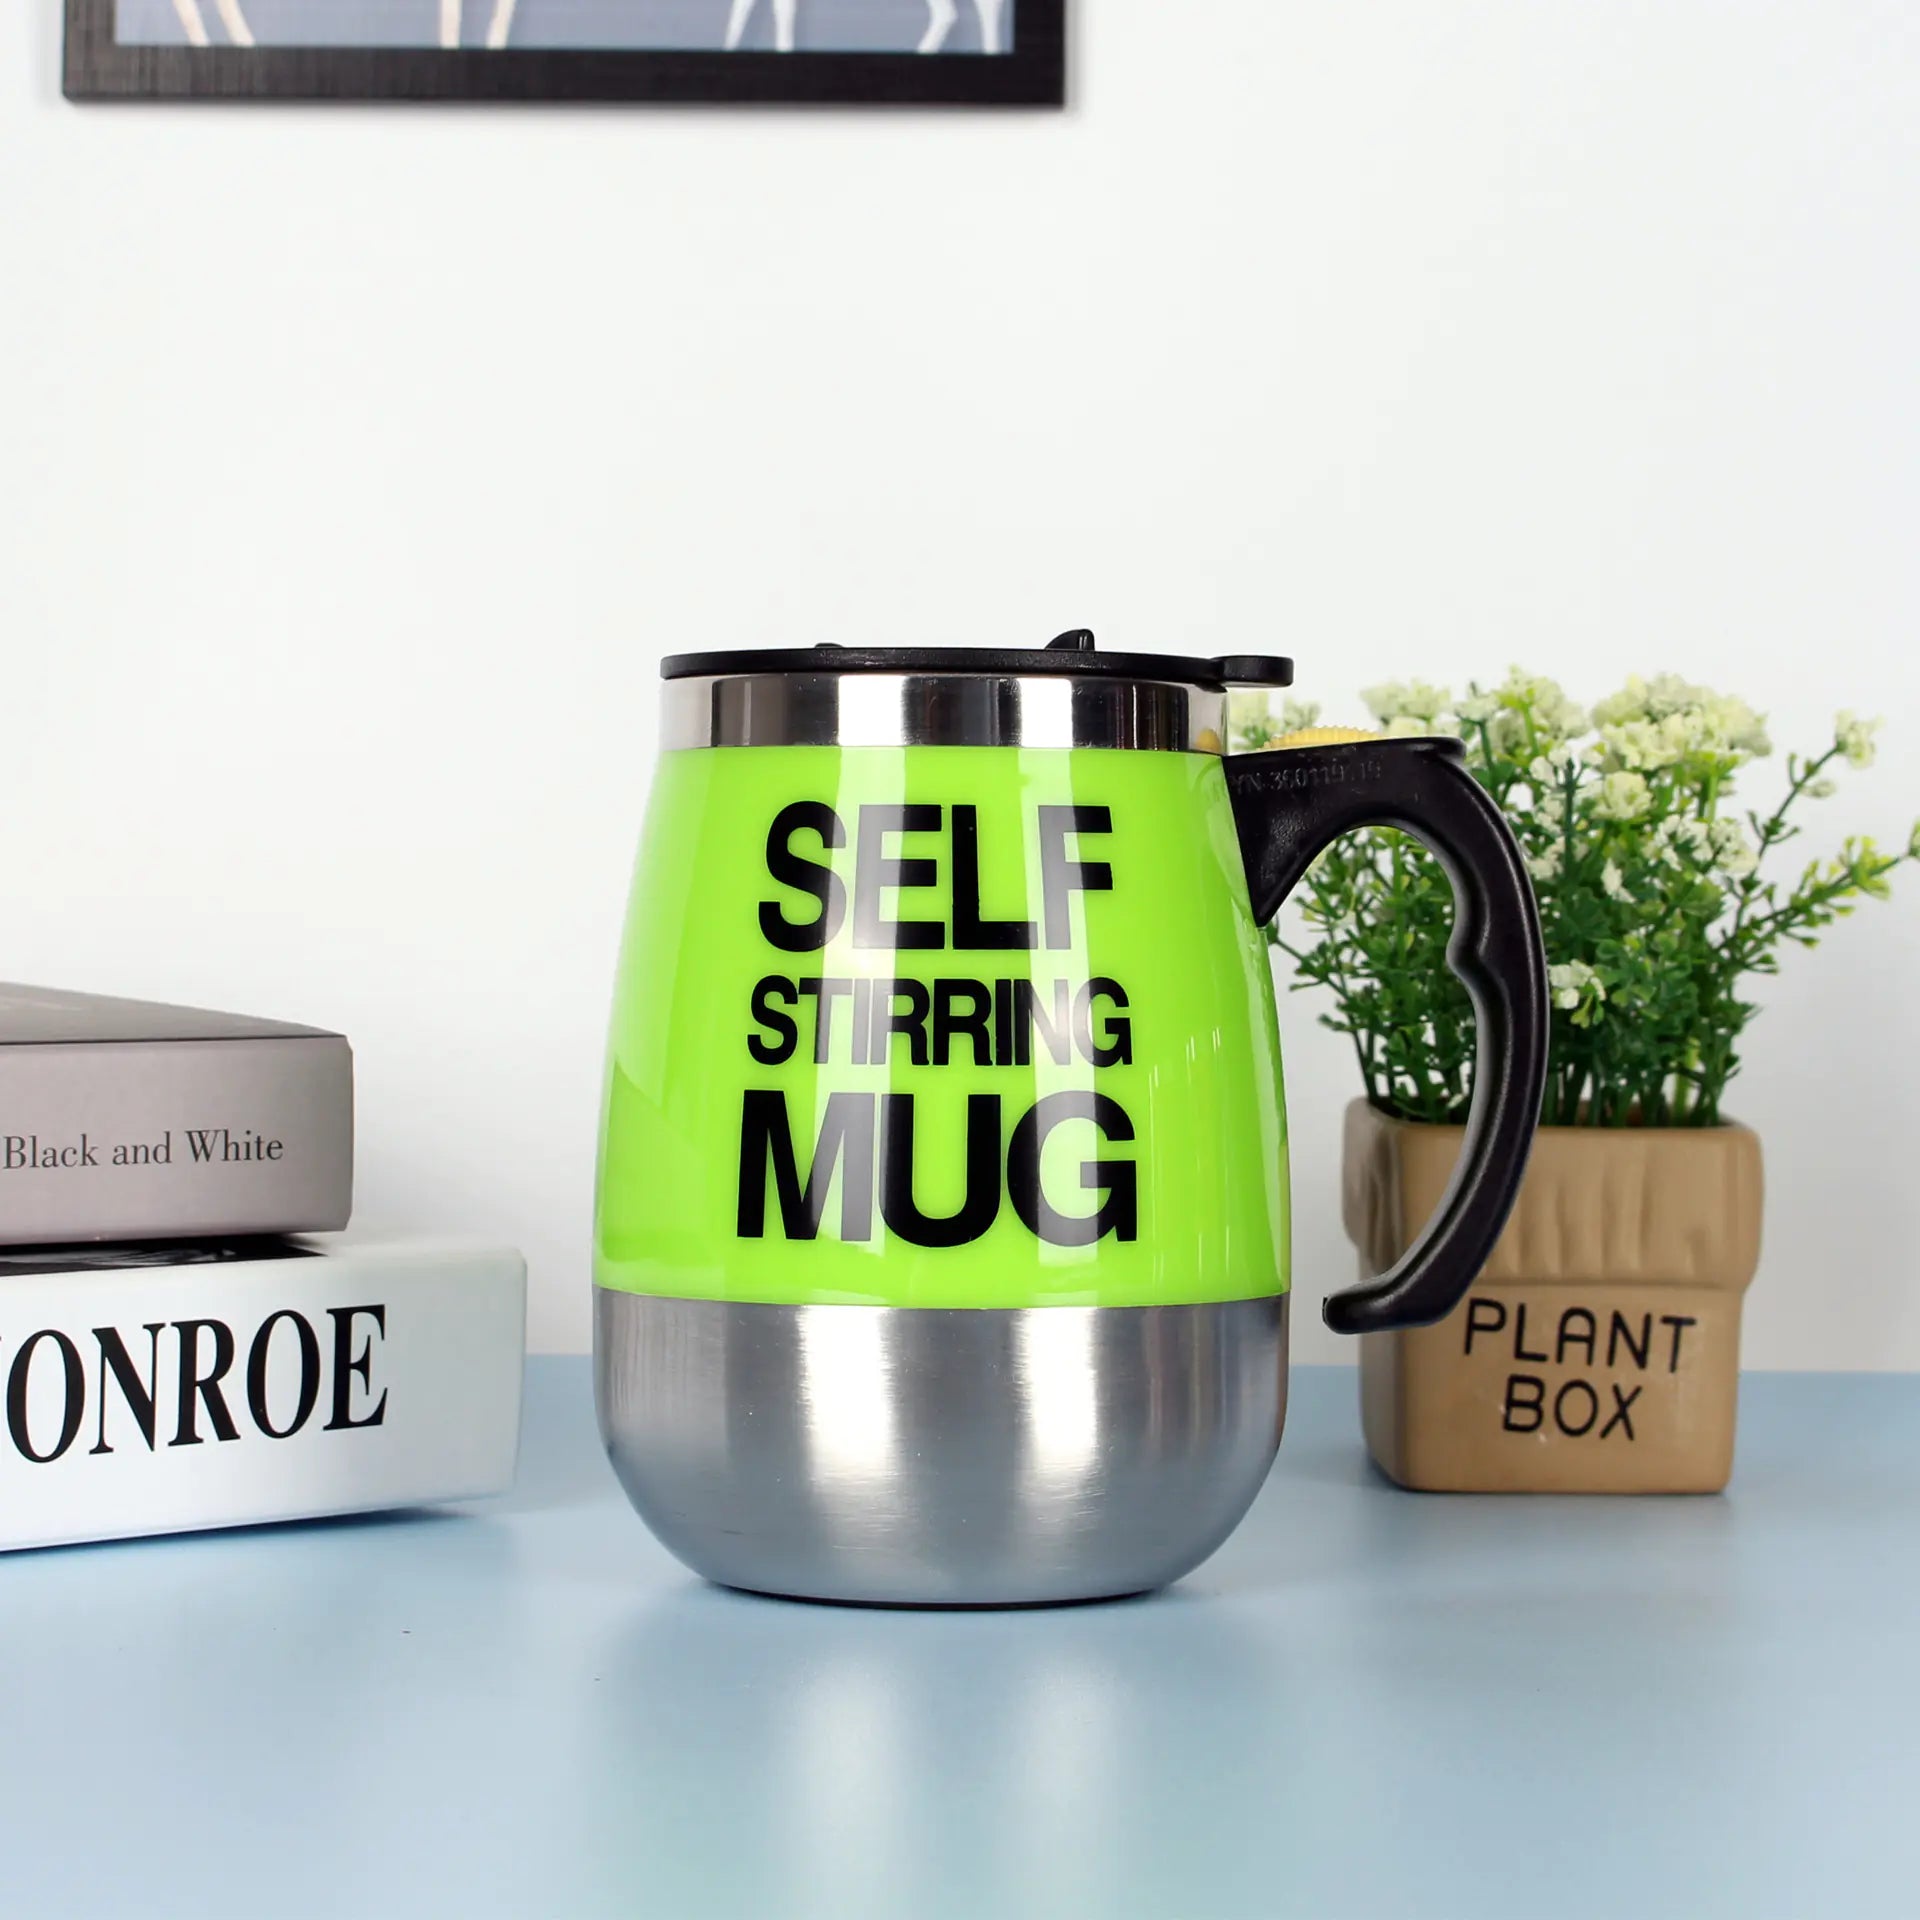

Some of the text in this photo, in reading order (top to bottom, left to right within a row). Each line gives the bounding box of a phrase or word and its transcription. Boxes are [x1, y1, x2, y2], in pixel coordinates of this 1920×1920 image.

[758, 800, 1113, 952] SELF
[747, 975, 1133, 1067] STIRRING
[2, 1128, 284, 1170] Black and White
[737, 1089, 1138, 1248] MUG
[1463, 1297, 1697, 1374] PLANT
[0, 1304, 389, 1463] ONROE
[1502, 1373, 1642, 1441] BOX
